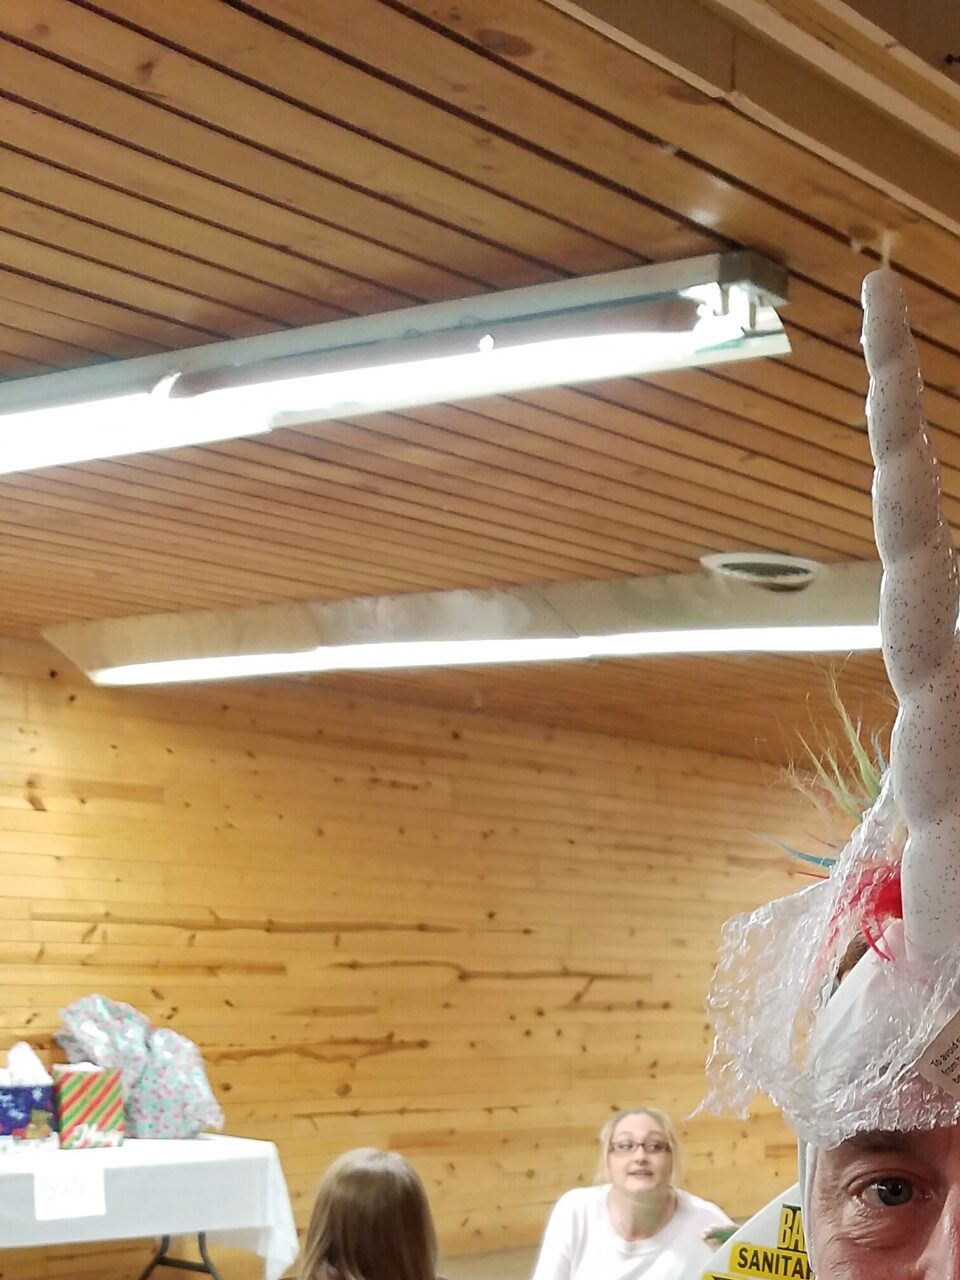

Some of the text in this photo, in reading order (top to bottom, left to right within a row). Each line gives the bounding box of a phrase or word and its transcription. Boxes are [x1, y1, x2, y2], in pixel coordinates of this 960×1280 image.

[930, 1059, 943, 1067] To
[940, 1042, 958, 1061] avoid
[940, 1061, 959, 1076] from
[778, 1207, 806, 1251] BA
